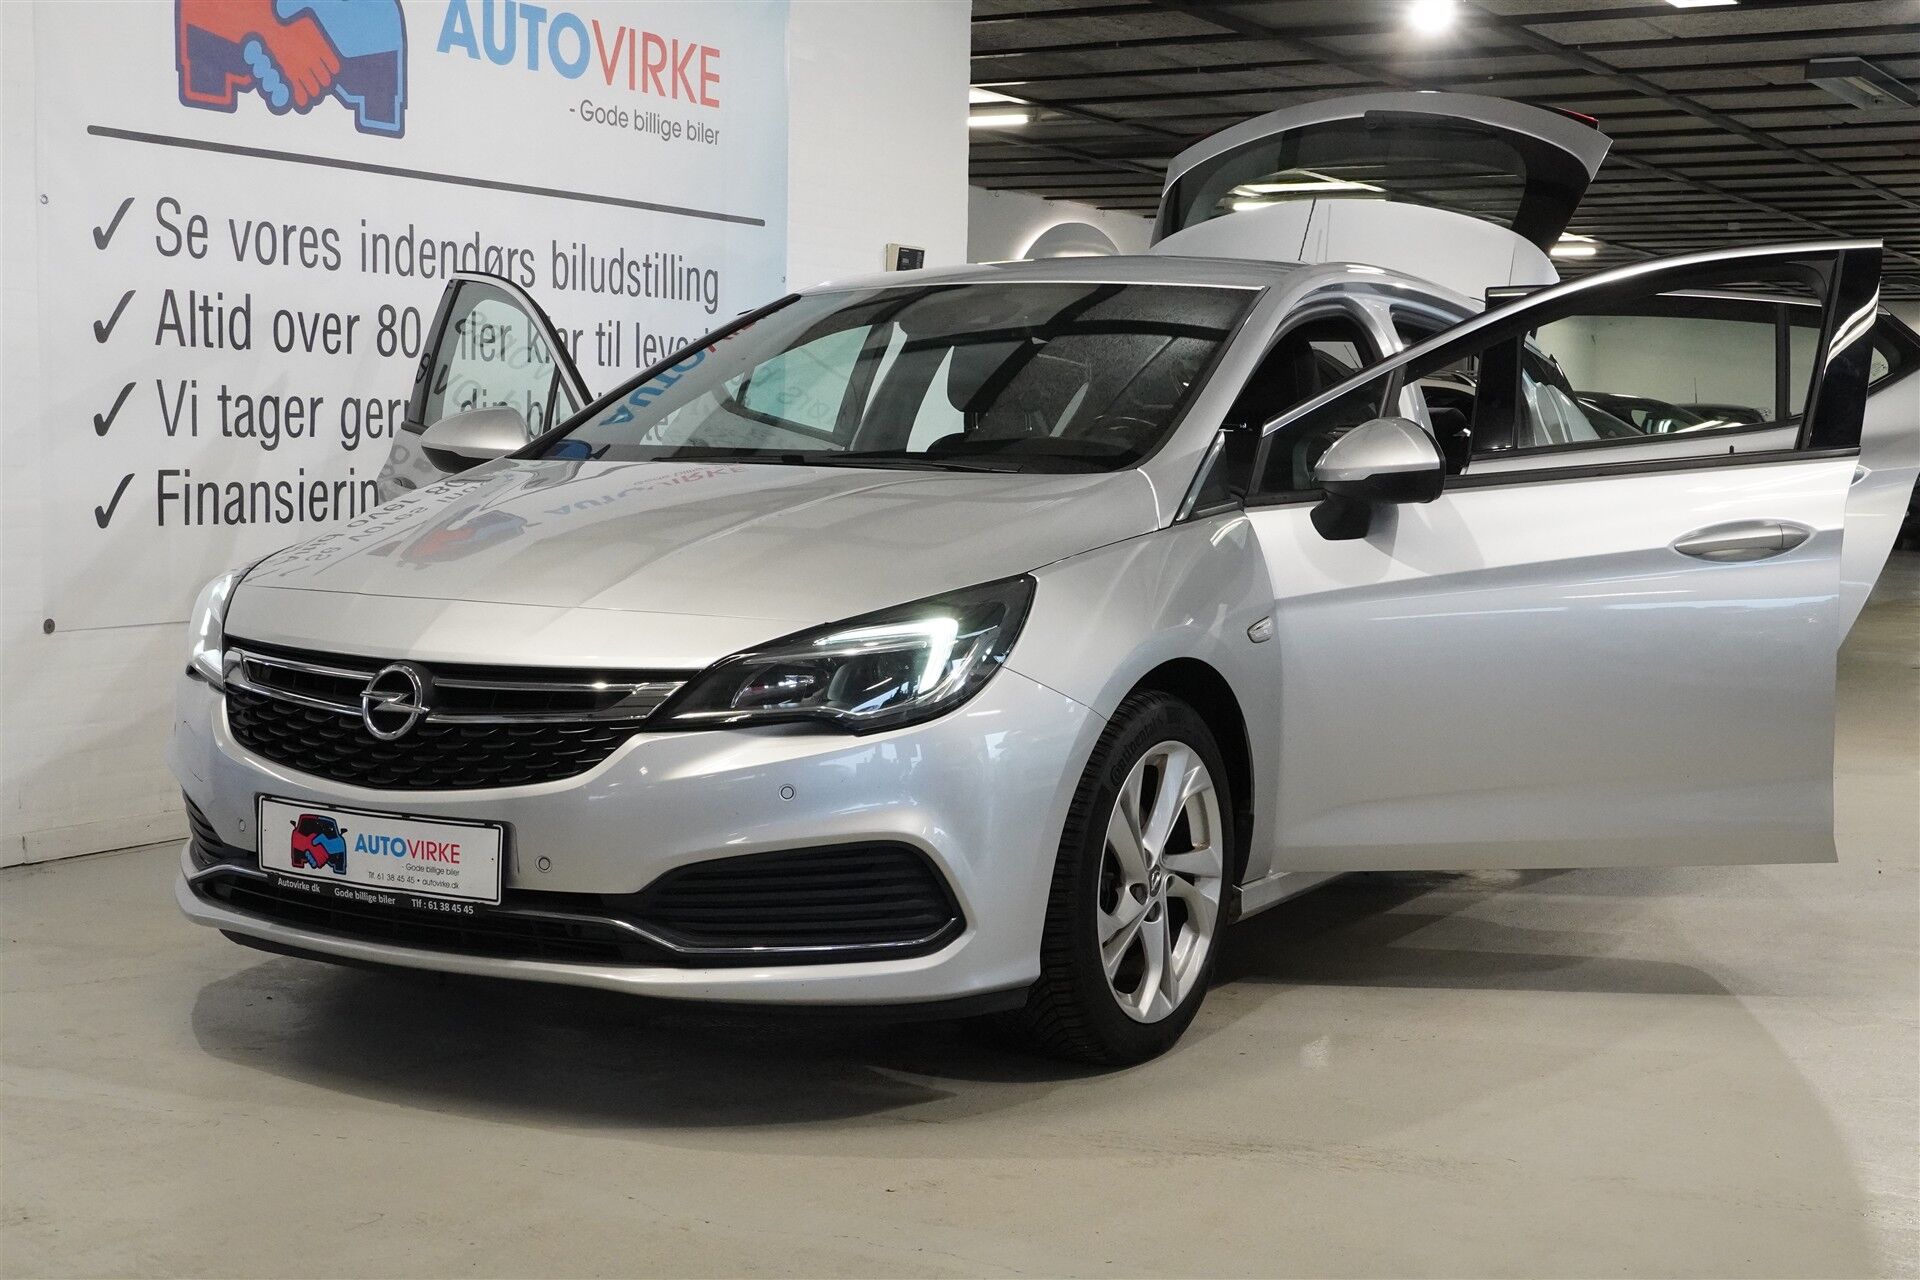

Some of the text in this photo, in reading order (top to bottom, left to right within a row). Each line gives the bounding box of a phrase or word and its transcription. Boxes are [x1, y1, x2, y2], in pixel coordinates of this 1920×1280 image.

[436, 0, 720, 108] AUTOVIRKE
[580, 99, 629, 128] Gode
[634, 109, 682, 141] billige
[686, 119, 720, 146] biler
[155, 197, 719, 314] Se vores indendørs biludstilling
[155, 288, 251, 350] Altid
[273, 309, 361, 355] over
[376, 304, 422, 358] 80
[595, 320, 621, 367] til
[156, 379, 198, 437] Vi
[217, 384, 324, 451] tager
[354, 833, 460, 864] AUTOVIRKE
[405, 863, 425, 872] Gode
[425, 866, 445, 876] billige
[446, 868, 460, 876] biler
[277, 877, 310, 891] Autovirke
[334, 887, 354, 899] Gode
[354, 890, 377, 904] billige
[378, 893, 396, 905] biler
[411, 898, 423, 908] Tlf
[428, 900, 438, 910] 61
[439, 902, 450, 912] 38
[451, 903, 462, 913] 45
[463, 904, 474, 914] 45
[376, 872, 384, 880] 61
[386, 874, 395, 882] 38
[396, 875, 406, 883] 45
[406, 876, 416, 884] 45
[422, 878, 459, 890] autovirke.dk
